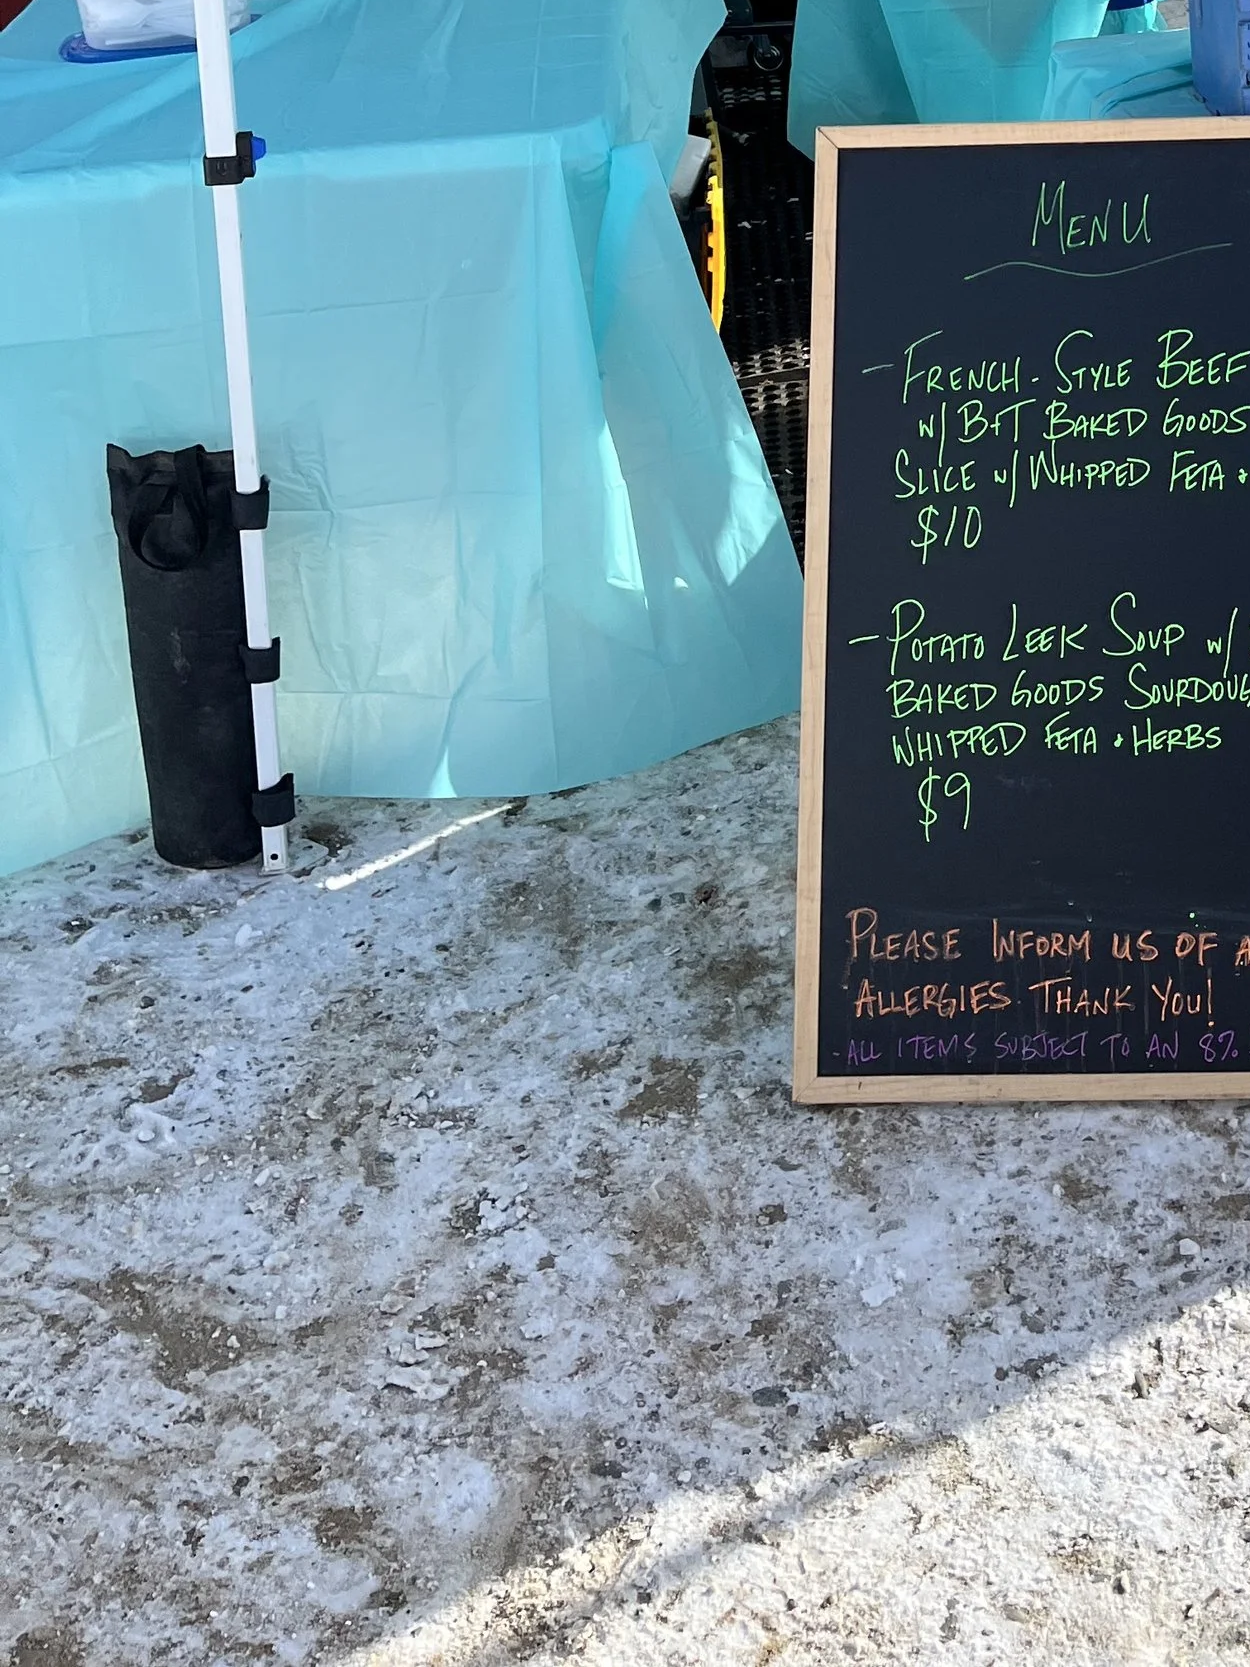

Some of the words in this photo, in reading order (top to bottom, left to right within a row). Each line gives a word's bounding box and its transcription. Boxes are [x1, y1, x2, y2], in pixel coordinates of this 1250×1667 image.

[1031, 180, 1152, 255] MENU
[1042, 399, 1149, 441] BAKED
[894, 448, 976, 499] SLICE
[1029, 440, 1151, 491] WHIPPED
[1168, 449, 1226, 493] FETA
[910, 504, 982, 565] $10
[1002, 603, 1088, 662] LEEK
[1102, 591, 1186, 657] SOUP
[886, 678, 998, 719] BAKED
[1011, 669, 1105, 708] GOODS
[891, 721, 1027, 767] WHIPPED
[1044, 711, 1098, 755] FETA
[1131, 717, 1222, 757] HERBS
[917, 766, 971, 843] $9
[845, 906, 962, 963] PLEASE
[991, 917, 1093, 963] INFORM
[1111, 929, 1159, 963] US
[1174, 931, 1219, 967] OF
[1028, 976, 1136, 1018] THANK
[994, 1030, 1089, 1063] SUBJECT
[1198, 1030, 1240, 1064] 8%
